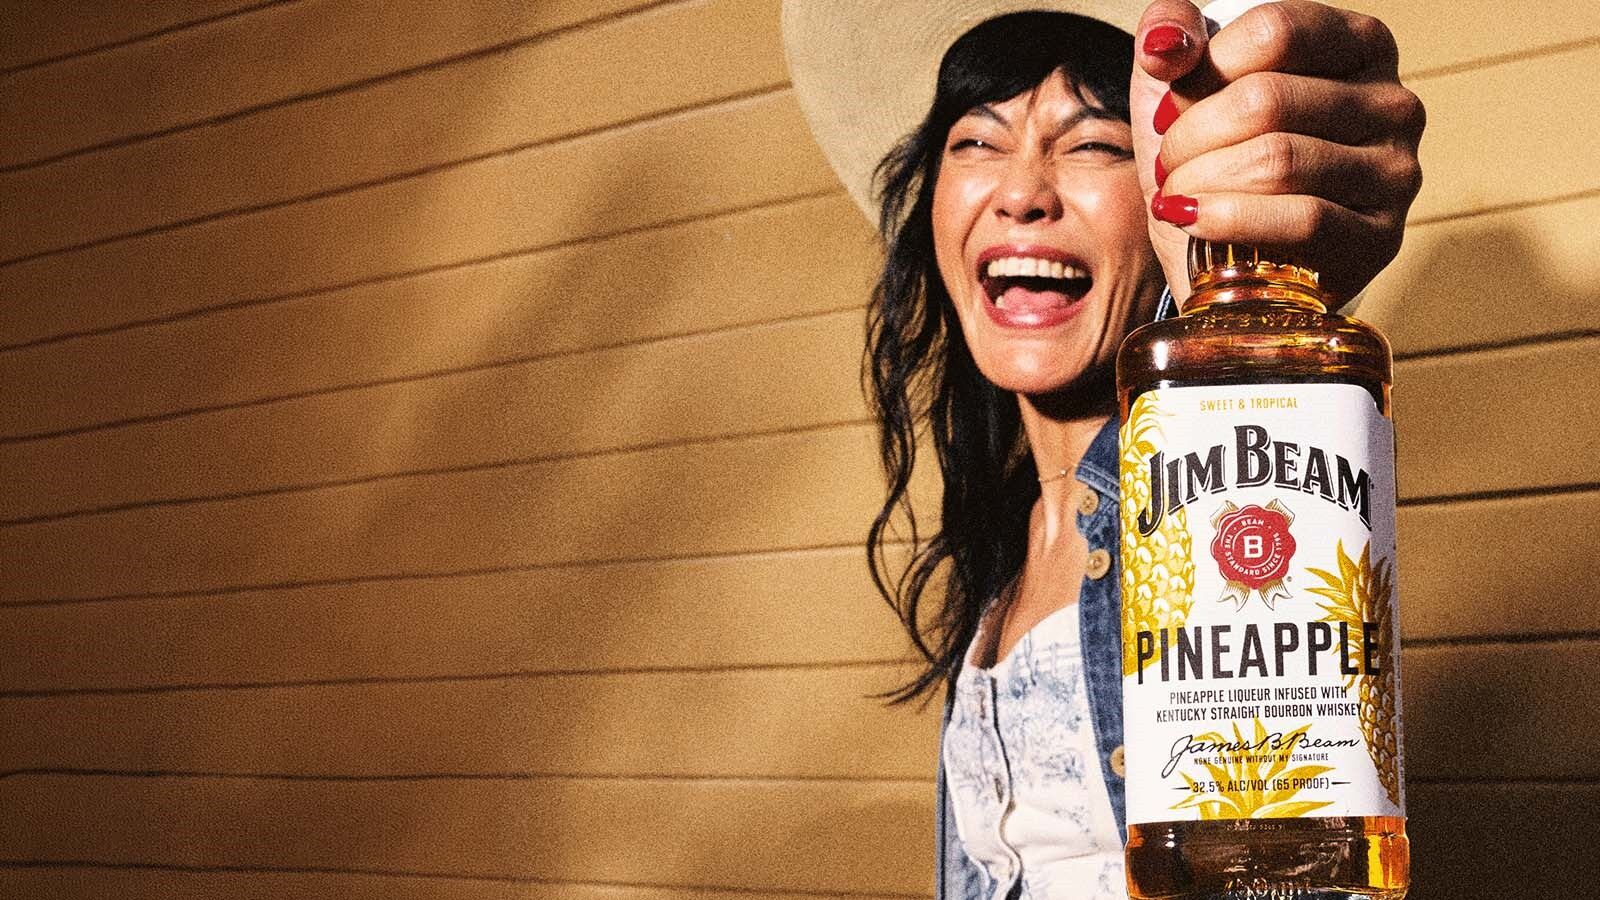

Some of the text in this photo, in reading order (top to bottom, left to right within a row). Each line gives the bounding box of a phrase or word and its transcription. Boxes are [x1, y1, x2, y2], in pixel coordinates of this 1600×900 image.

[1200, 397, 1298, 411] SWEET & TROPICAL
[1137, 424, 1373, 538] JIM BEAM
[1241, 519, 1264, 527] BEAM
[1224, 534, 1233, 549] THE
[1243, 535, 1263, 559] B
[1225, 551, 1260, 576] STANDARD
[1262, 553, 1281, 573] SINCE
[1136, 621, 1381, 685] PINEAPPLE
[1169, 686, 1348, 705] PINEAPPLE LIQUEUR INFUSED WITH
[1156, 703, 1363, 723] KENTUCKY STRAIGHT BOURBON WHISKEY
[1161, 734, 1256, 778] James
[1282, 732, 1361, 751] Beam
[1194, 752, 1329, 765] NONE GENUINE WITHOUT MY SIGNATURE
[1192, 780, 1225, 793] 32.5%
[1227, 778, 1269, 792] ALC/VOL
